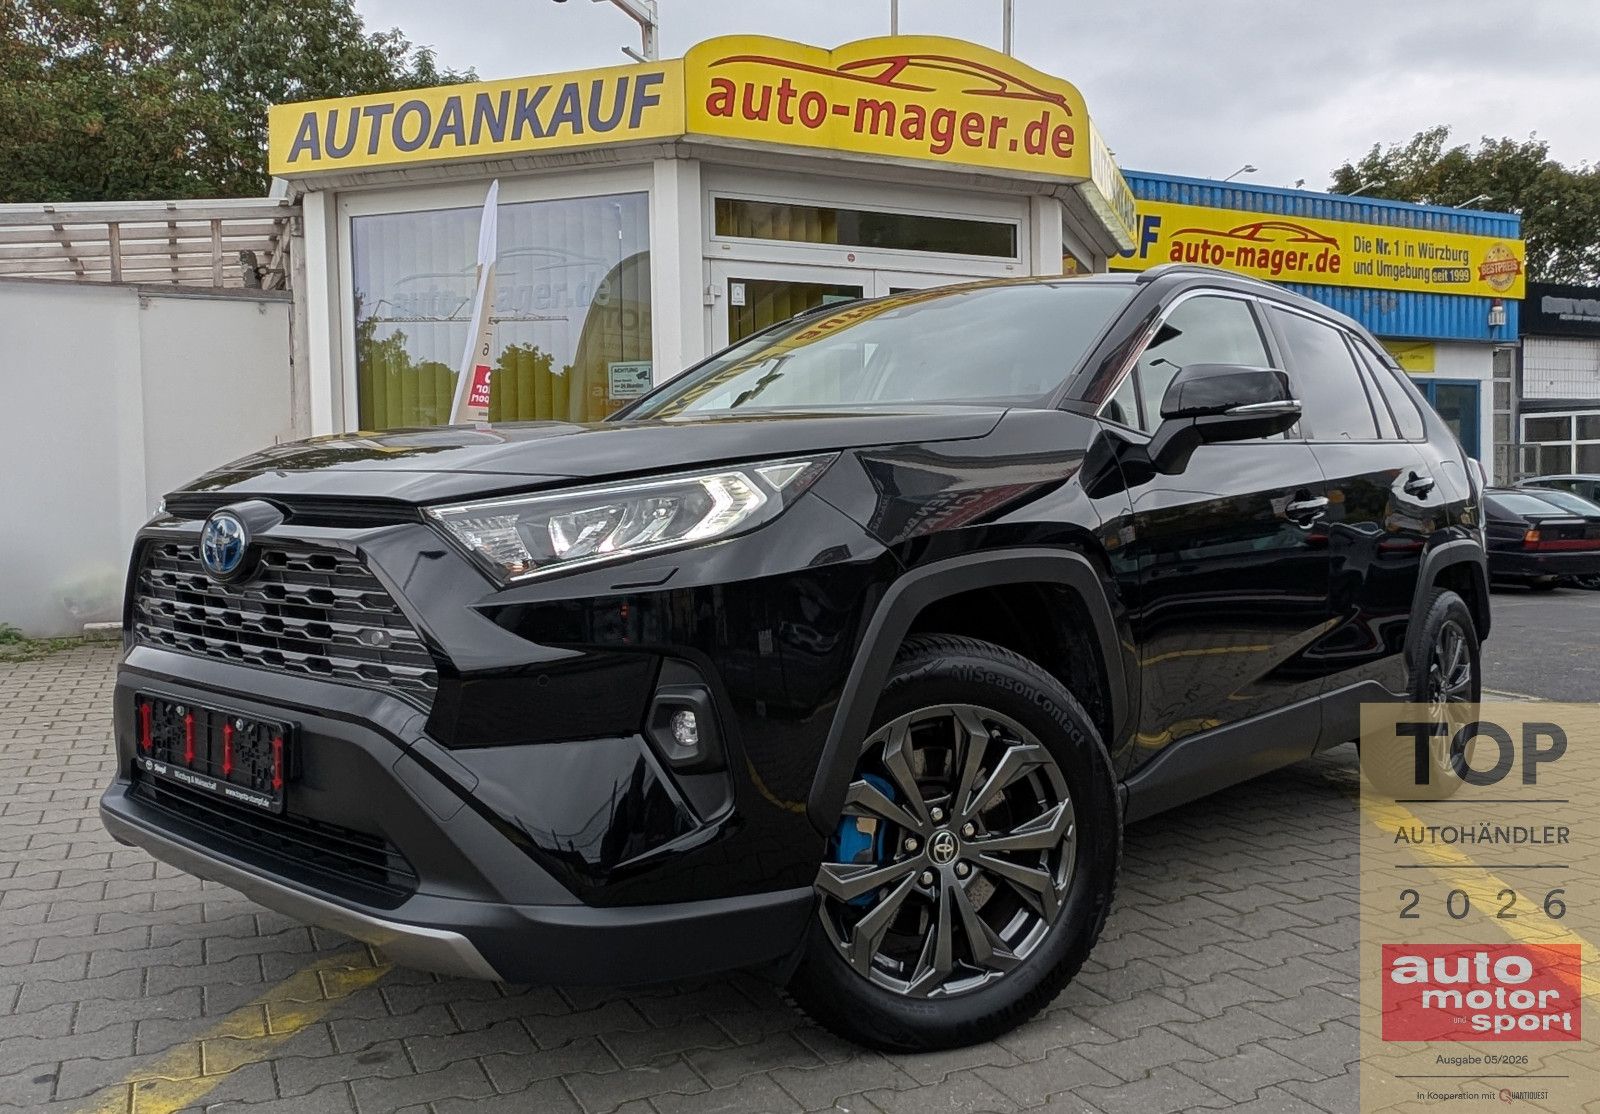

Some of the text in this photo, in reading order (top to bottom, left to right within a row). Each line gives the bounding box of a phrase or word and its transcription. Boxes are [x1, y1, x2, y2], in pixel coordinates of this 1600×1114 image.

[287, 72, 665, 163] AUTOANKAUF
[705, 77, 1075, 159] auto-mager.de
[1169, 238, 1341, 275] auto-mager.de
[1354, 235, 1469, 266] Die Nr. 1 in Würzburg
[1354, 259, 1469, 283] und Umgebung seit 1999
[951, 664, 1085, 748] AllSeasonContact
